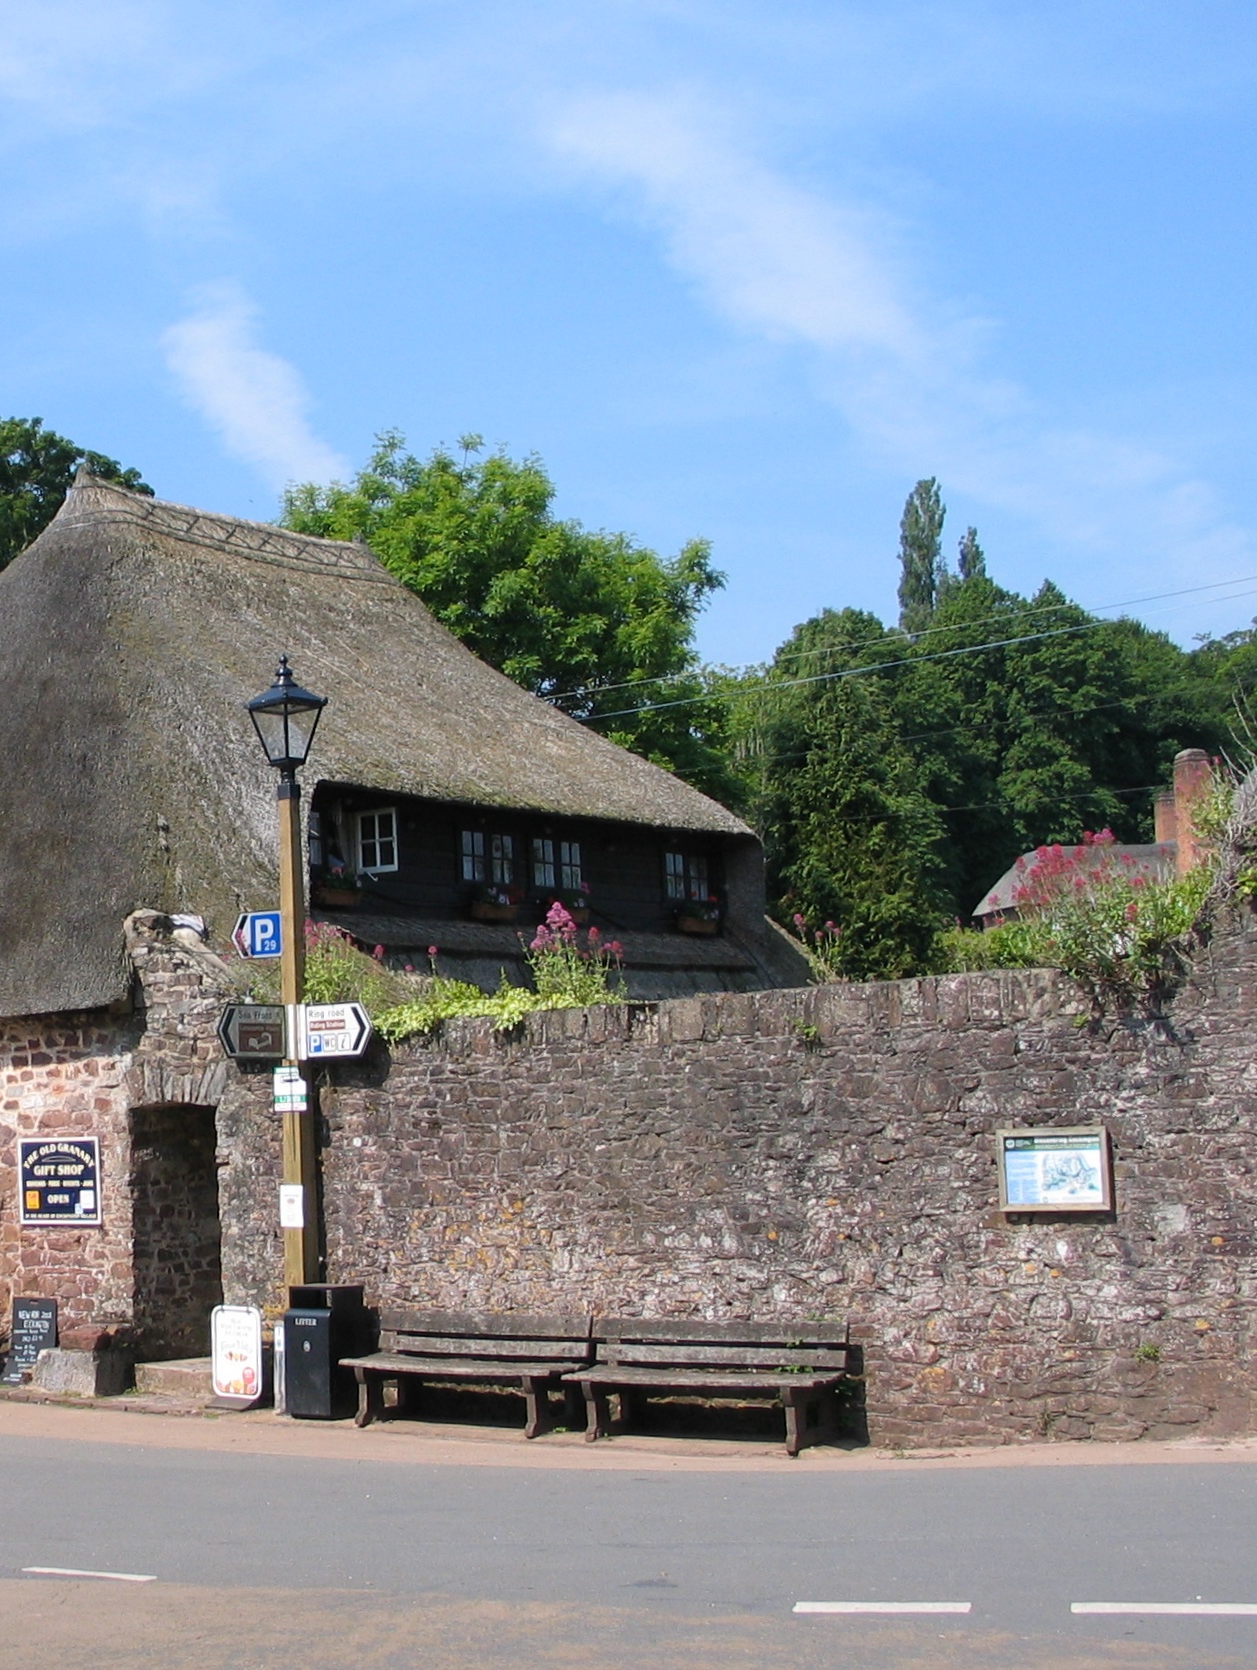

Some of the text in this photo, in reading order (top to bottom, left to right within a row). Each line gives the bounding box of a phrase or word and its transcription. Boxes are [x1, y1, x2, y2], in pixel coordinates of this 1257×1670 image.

[255, 918, 274, 952] P
[263, 939, 277, 951] 29
[23, 1143, 94, 1169] THE OLD GRANARY
[33, 1164, 84, 1176] GIFT SHOP
[47, 1194, 70, 1204] OPEN
[295, 1318, 317, 1326] LITTER
